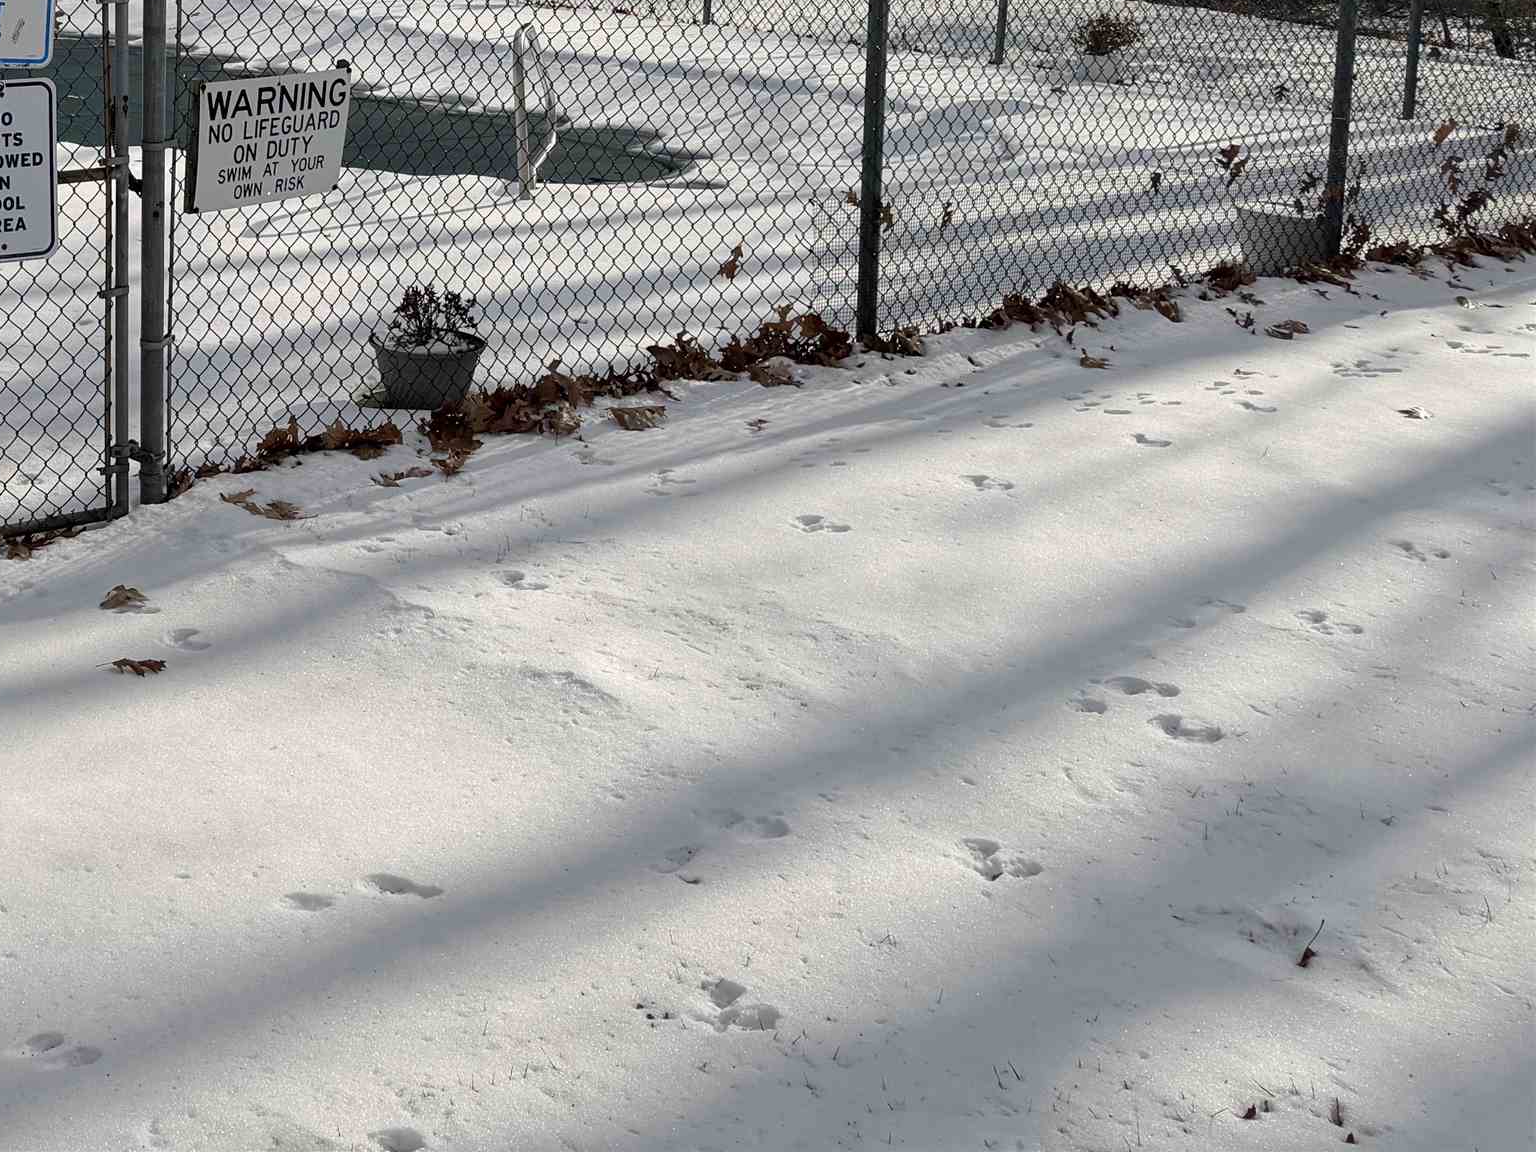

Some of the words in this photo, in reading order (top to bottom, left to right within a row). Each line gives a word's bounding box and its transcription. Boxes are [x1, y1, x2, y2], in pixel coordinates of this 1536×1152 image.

[207, 78, 346, 120] WARNING
[208, 123, 233, 144] NO
[243, 110, 340, 140] LIFEGUARD
[233, 143, 257, 164] ON
[267, 135, 313, 159] DUTY
[217, 166, 252, 184] SWIM
[263, 162, 279, 177] AT
[291, 155, 325, 173] YOUR
[233, 182, 263, 199] OWN
[275, 176, 304, 192] RISK
